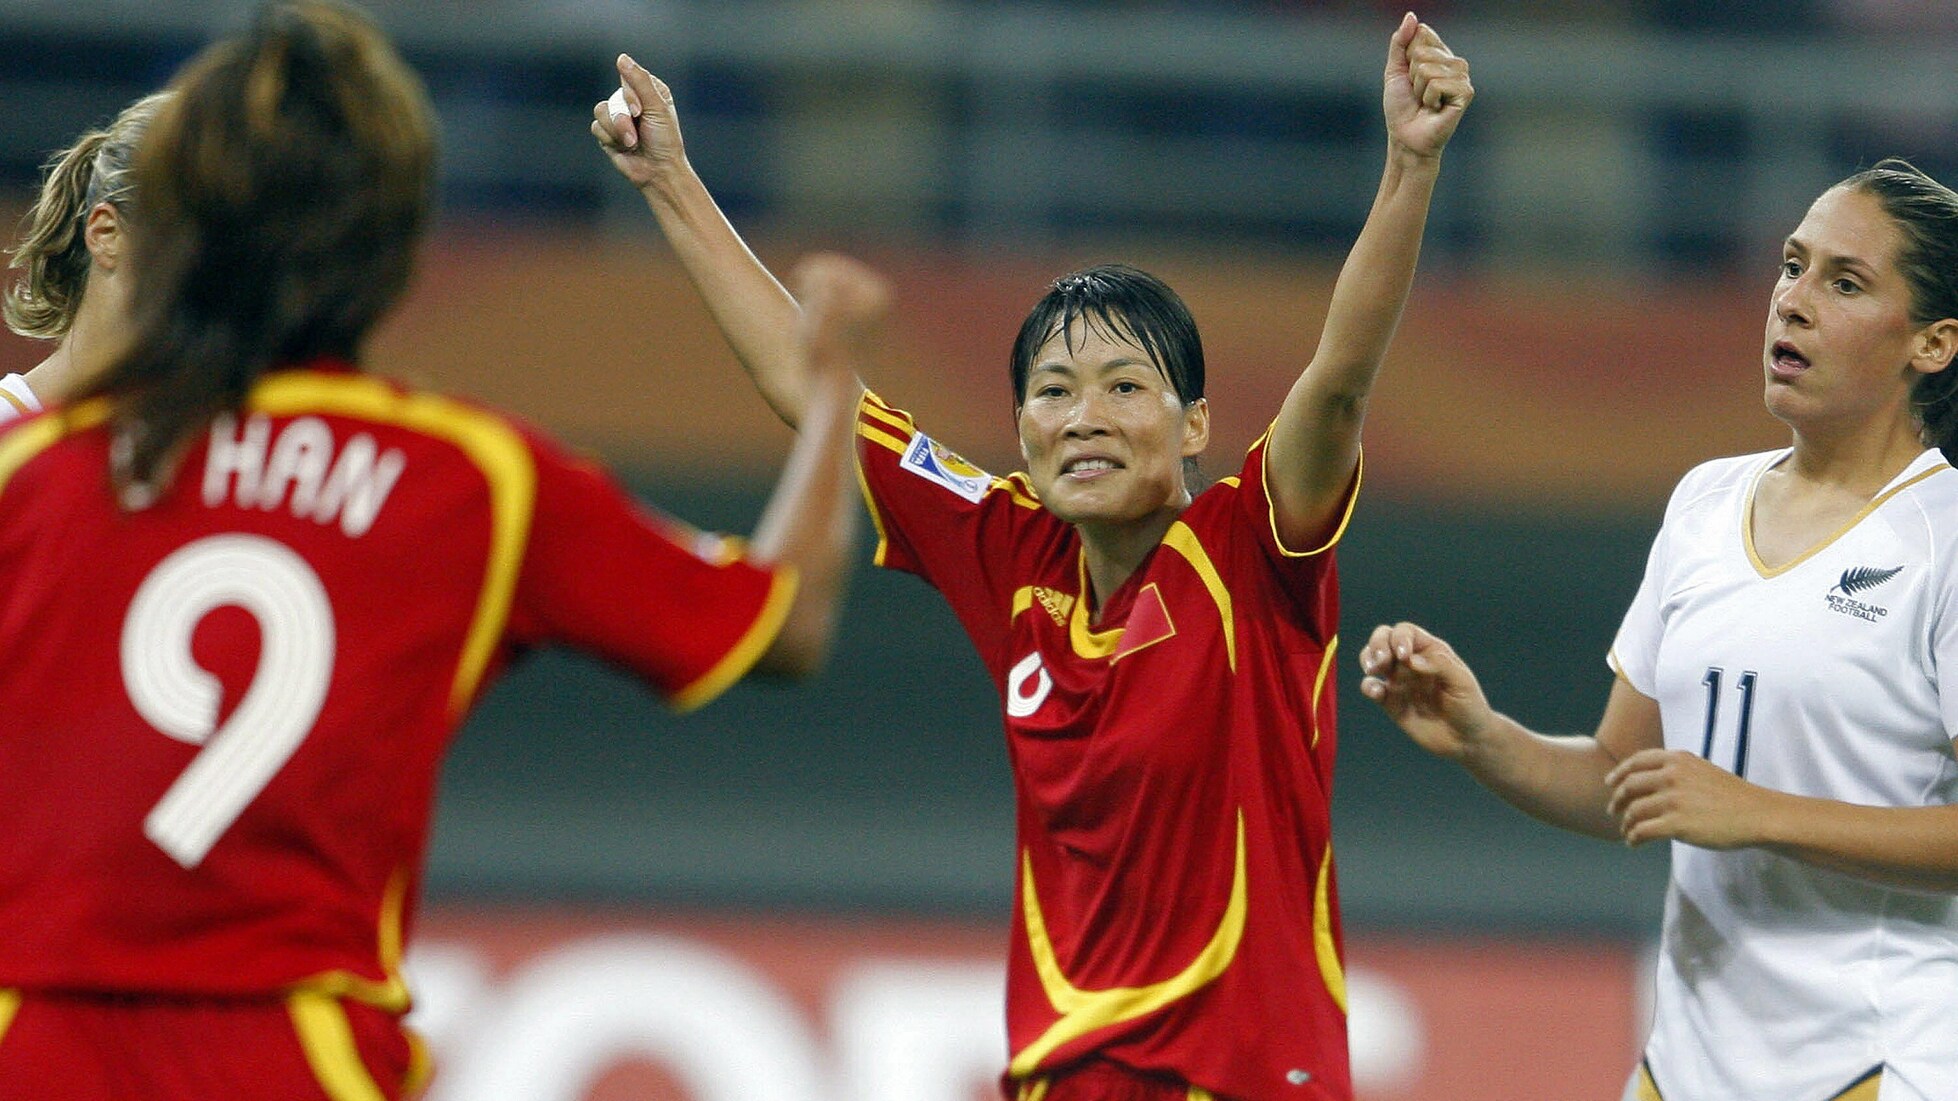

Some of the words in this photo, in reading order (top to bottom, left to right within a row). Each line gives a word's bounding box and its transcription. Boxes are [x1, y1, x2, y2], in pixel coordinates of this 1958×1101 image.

[203, 411, 406, 538] HAN
[1033, 586, 1066, 627] adidas
[1825, 594, 1845, 605] NEW
[1845, 598, 1888, 616] ZEALAND
[1828, 601, 1877, 622] FOOTBALL
[120, 532, 337, 869] 9
[1702, 667, 1758, 778] 11
